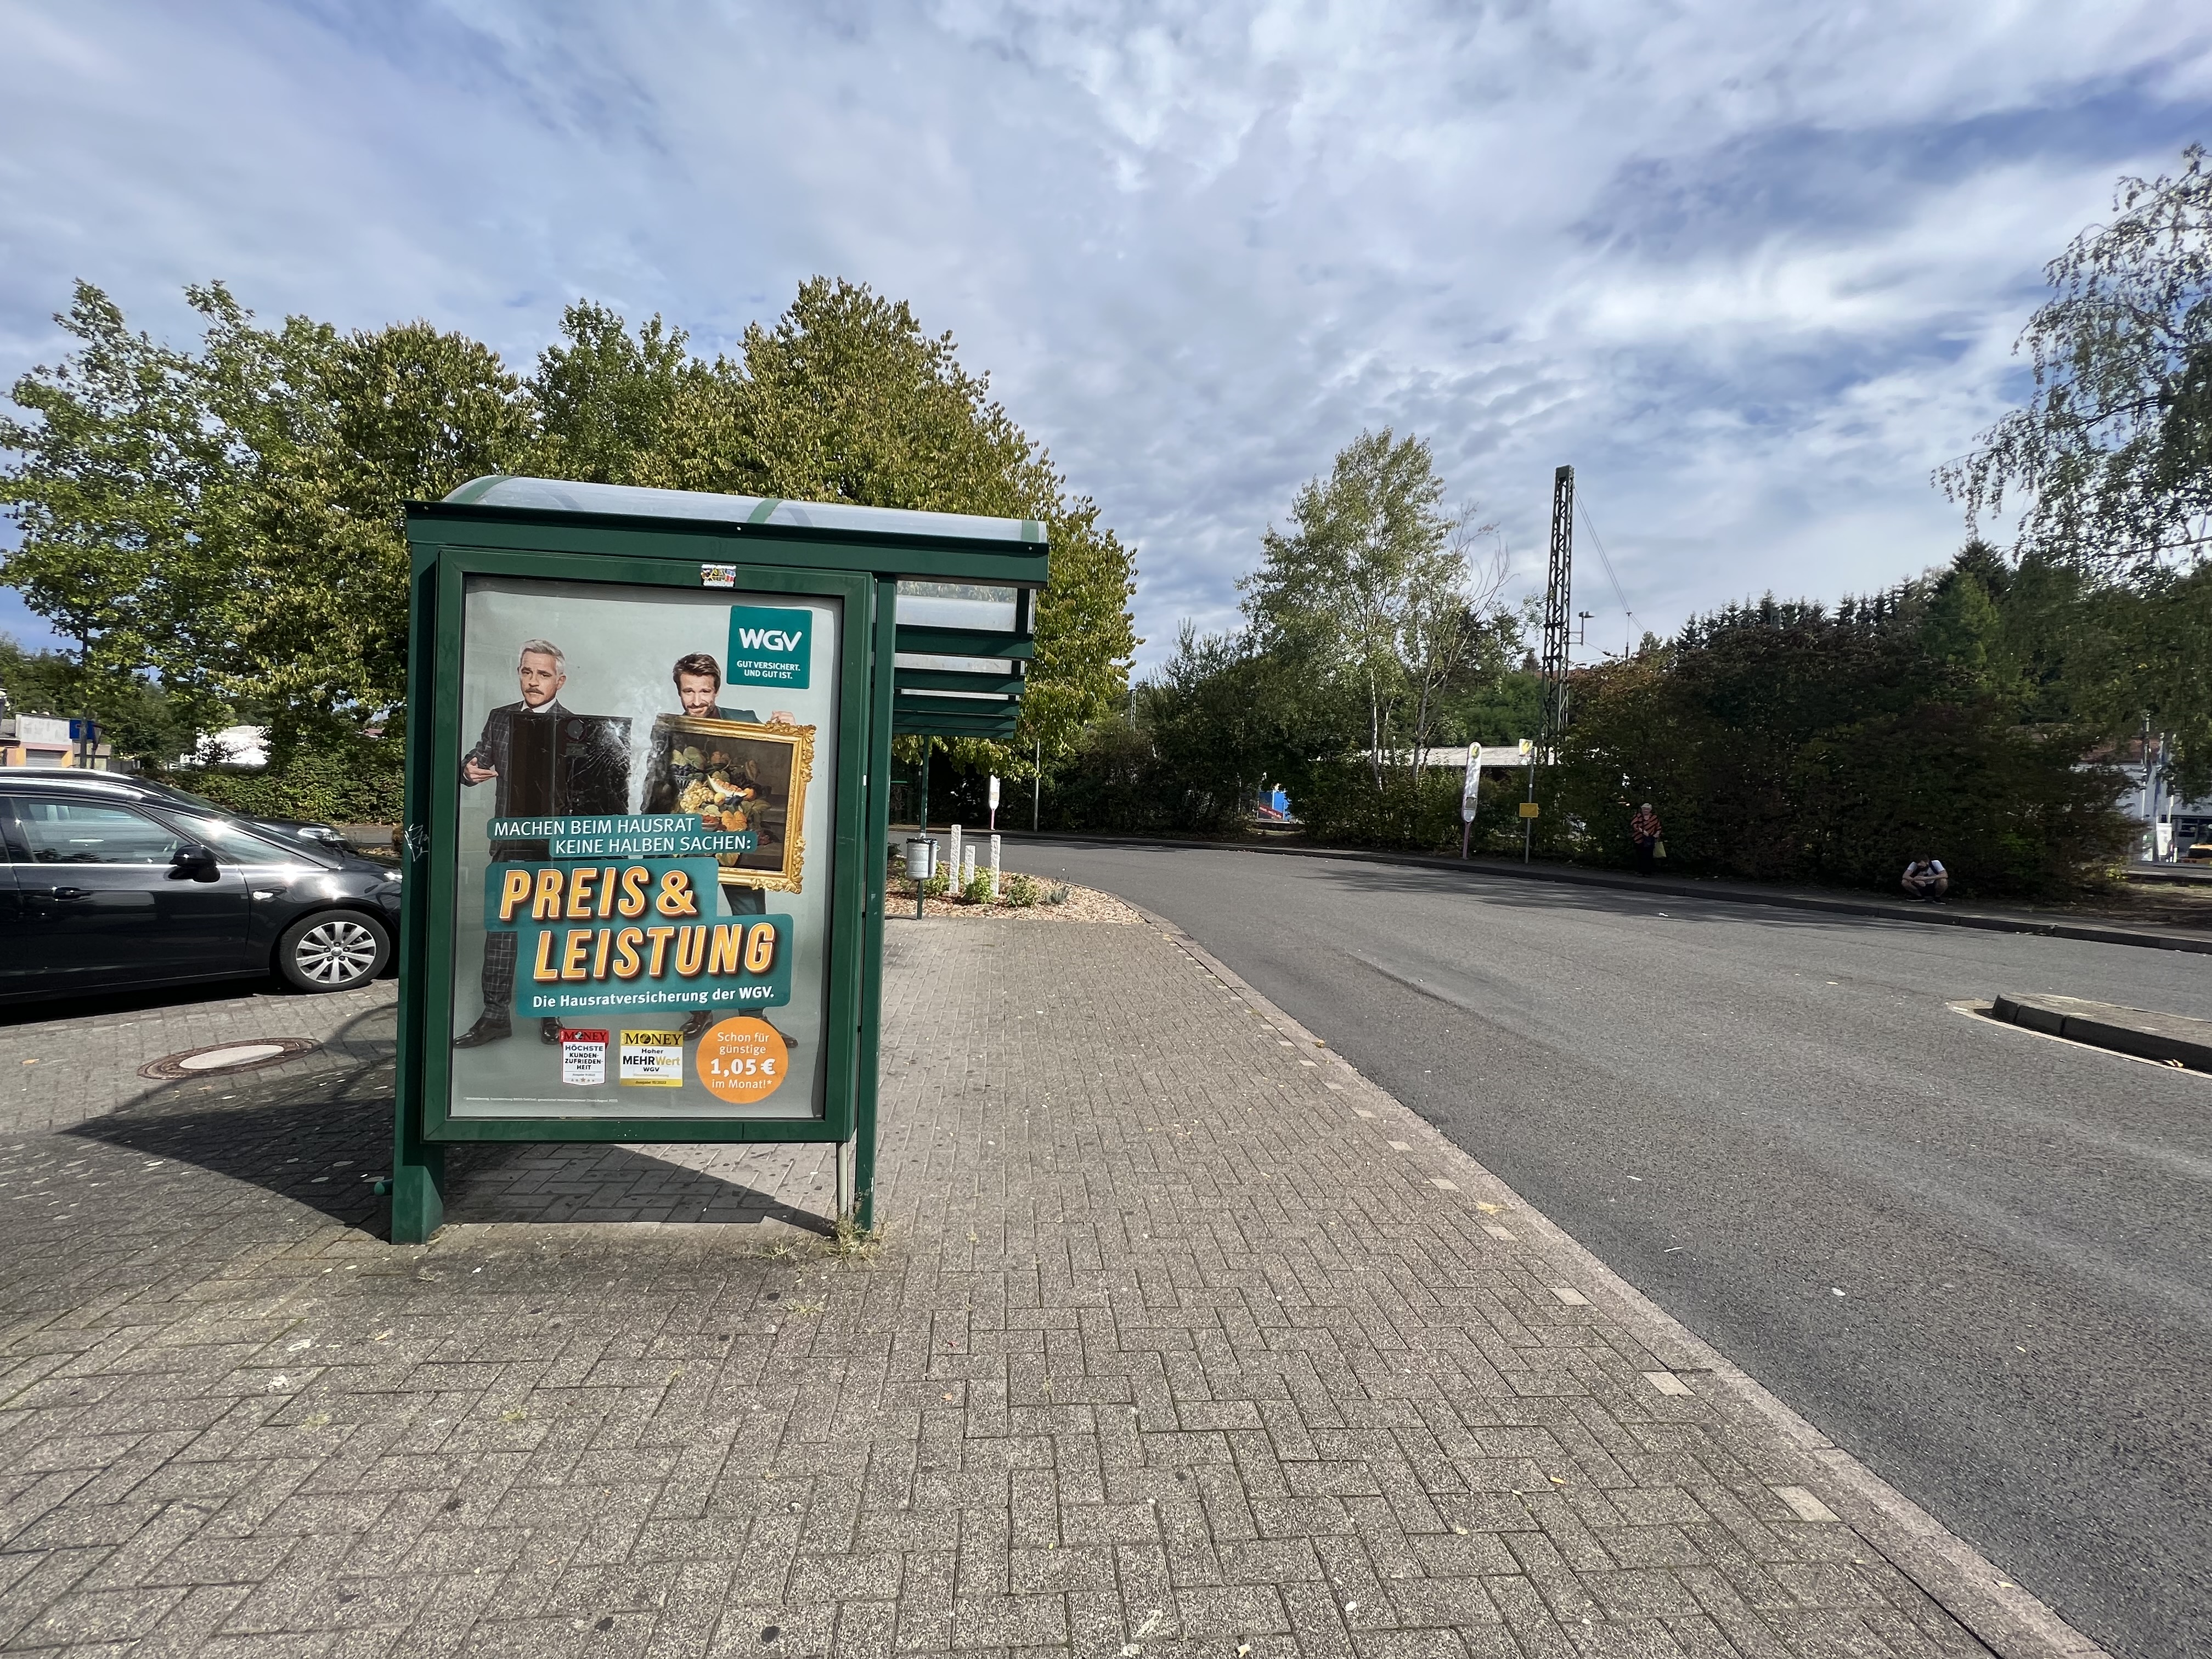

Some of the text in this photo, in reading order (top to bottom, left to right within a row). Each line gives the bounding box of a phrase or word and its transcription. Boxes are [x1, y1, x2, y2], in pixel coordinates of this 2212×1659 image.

[739, 628, 802, 651] WGV
[753, 662, 800, 671] VERSICHERT.
[494, 817, 695, 837] MACHEN BEIM HAUSRAT
[556, 836, 751, 854] KEINE HALBEN SACHEN:
[499, 866, 698, 921] PREIS &
[533, 922, 776, 982] LEISTUNG
[533, 986, 775, 1007] Die Hausratversicherung der WGV.
[625, 1033, 682, 1045] MONEY
[717, 1032, 770, 1042] Schon für
[719, 1044, 766, 1056] günstige
[623, 1056, 680, 1065] MEHRWert
[712, 1079, 725, 1088] im
